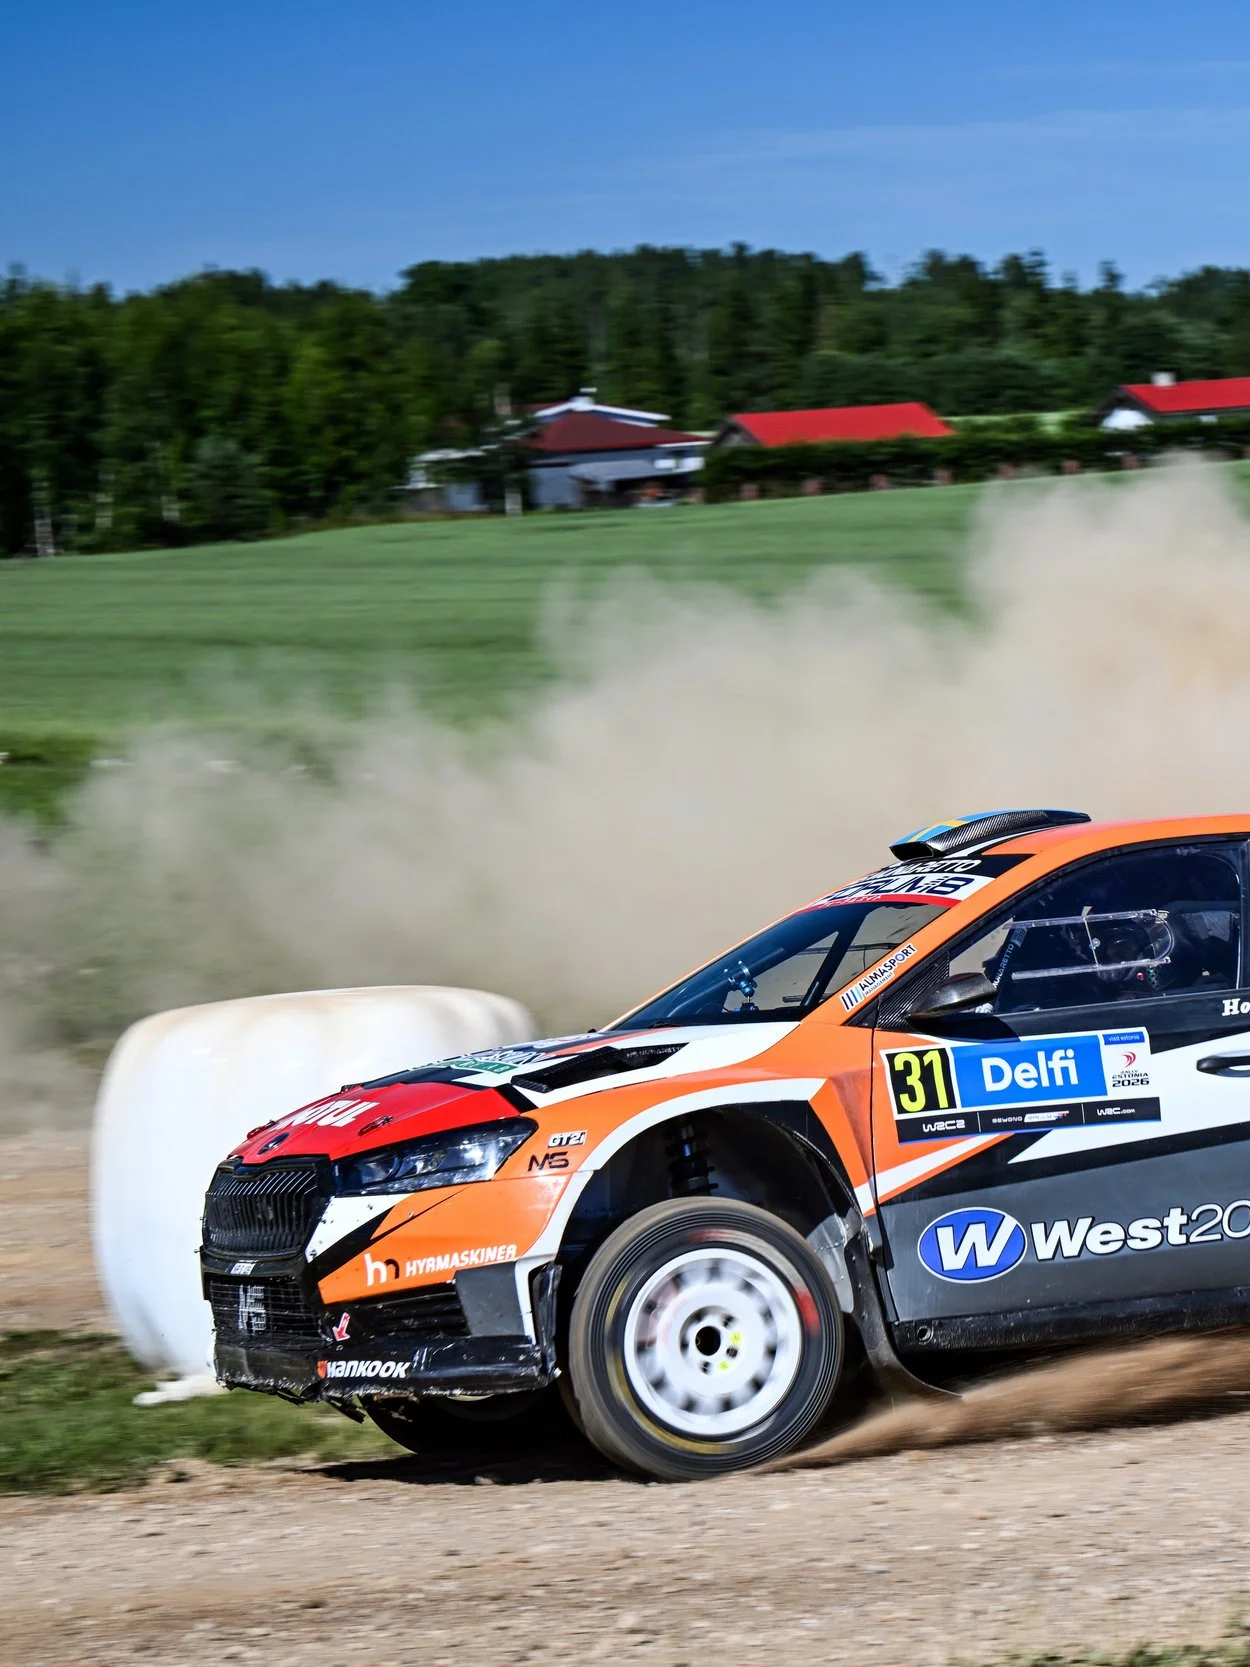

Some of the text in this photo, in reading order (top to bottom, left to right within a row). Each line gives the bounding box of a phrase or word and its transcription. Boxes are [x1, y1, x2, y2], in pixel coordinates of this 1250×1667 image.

[858, 944, 917, 991] ALMASPORT
[893, 1050, 949, 1113] 31
[981, 1048, 1079, 1092] Delfi
[1111, 1072, 1149, 1080] ESTONIA
[1112, 1078, 1150, 1088] 2026
[922, 1119, 966, 1133] WRC2
[404, 1244, 517, 1278] HYRMASKINER
